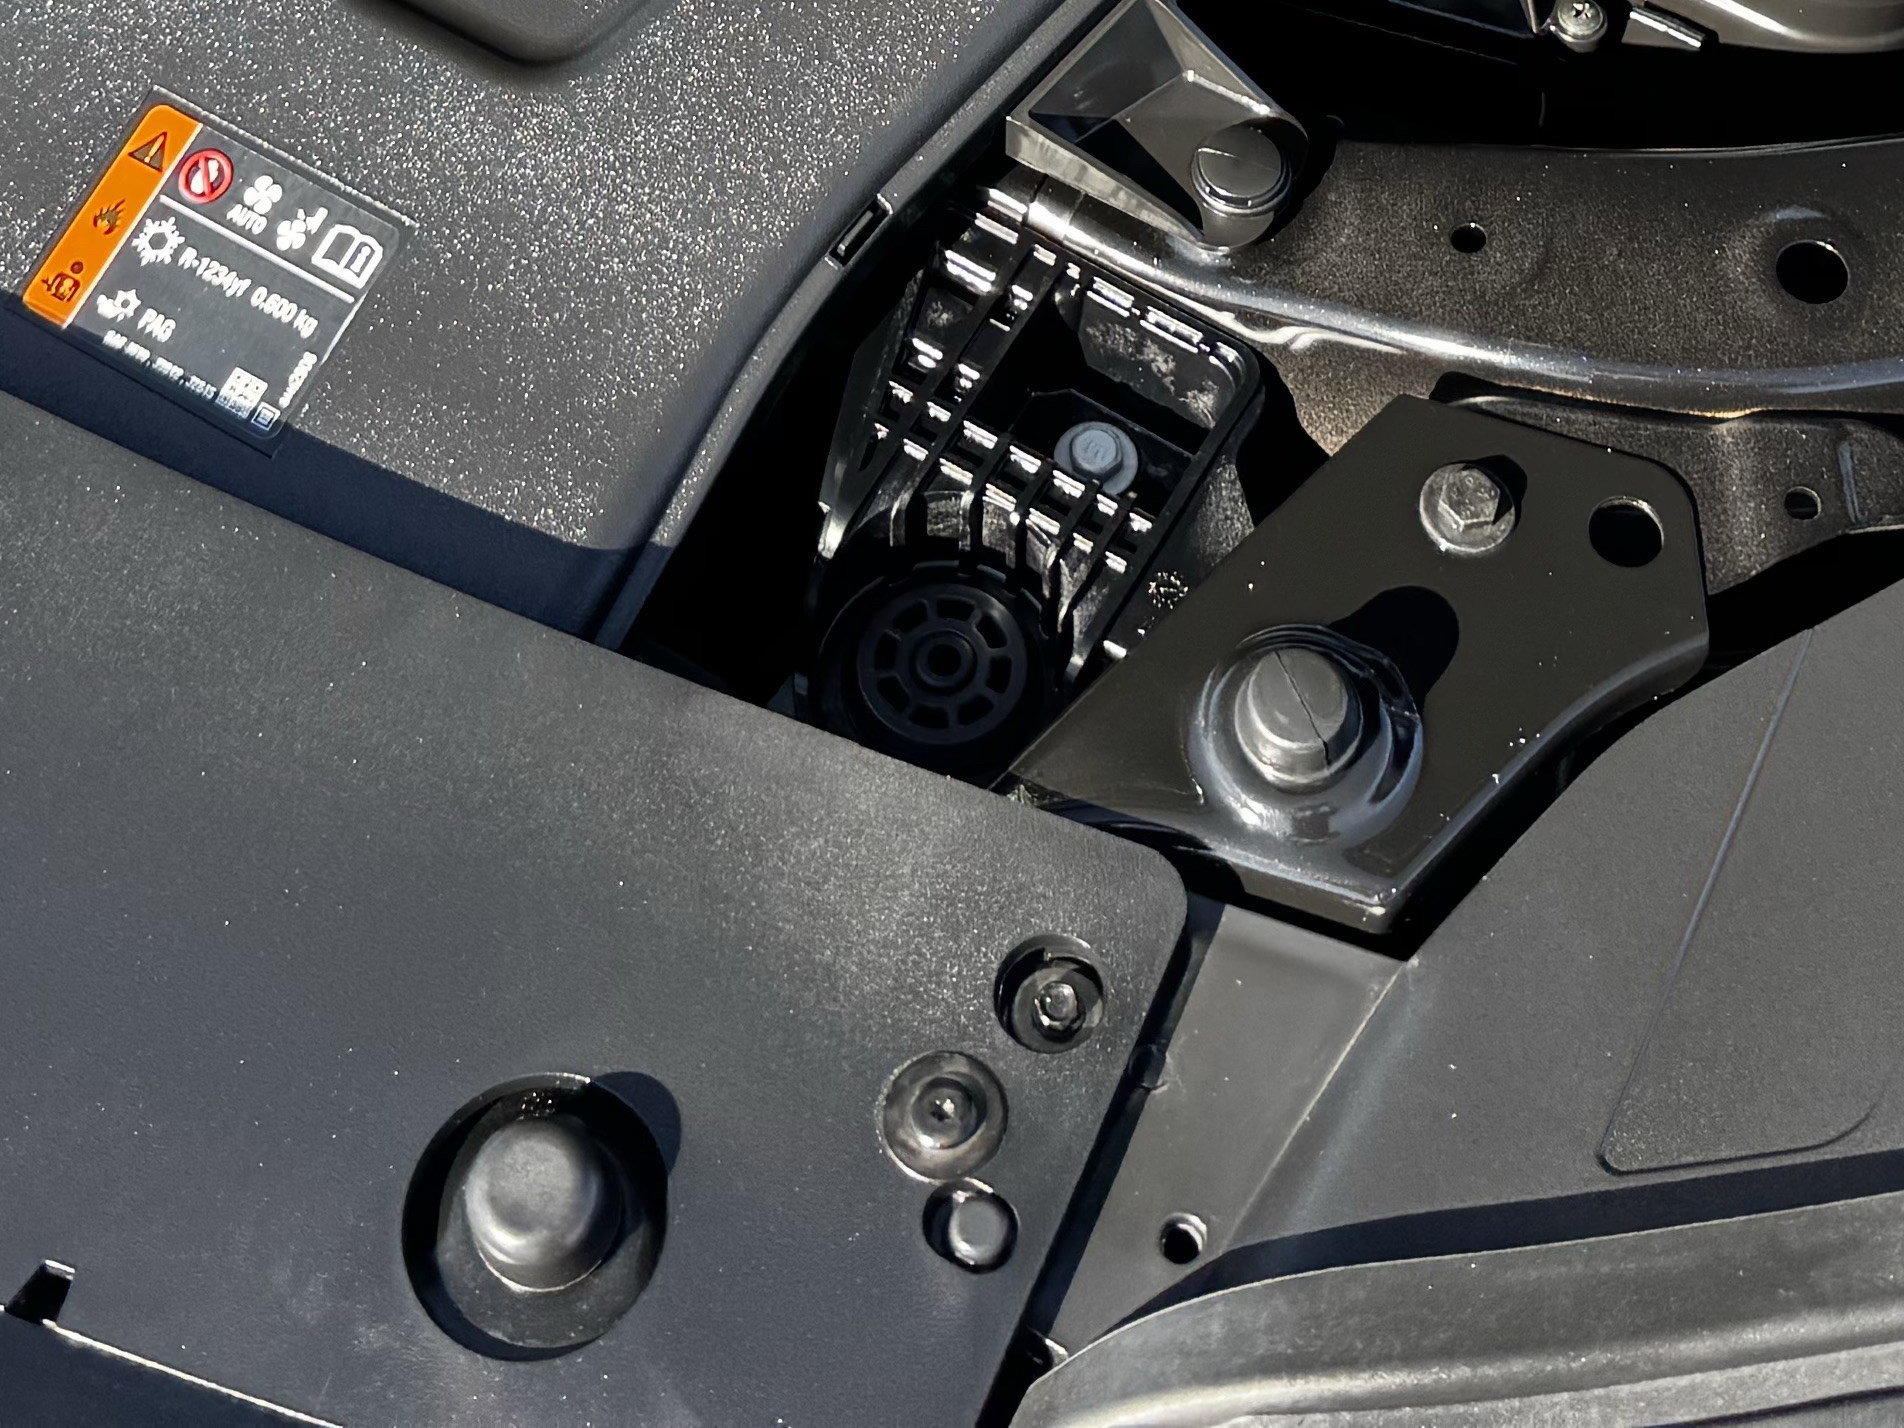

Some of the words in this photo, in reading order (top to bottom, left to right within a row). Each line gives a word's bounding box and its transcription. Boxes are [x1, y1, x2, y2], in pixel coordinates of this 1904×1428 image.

[226, 203, 268, 235] AUTO
[177, 245, 252, 298] R-1234yf
[250, 285, 298, 324] 0.600
[292, 308, 319, 339] kg
[136, 307, 177, 343] PAG
